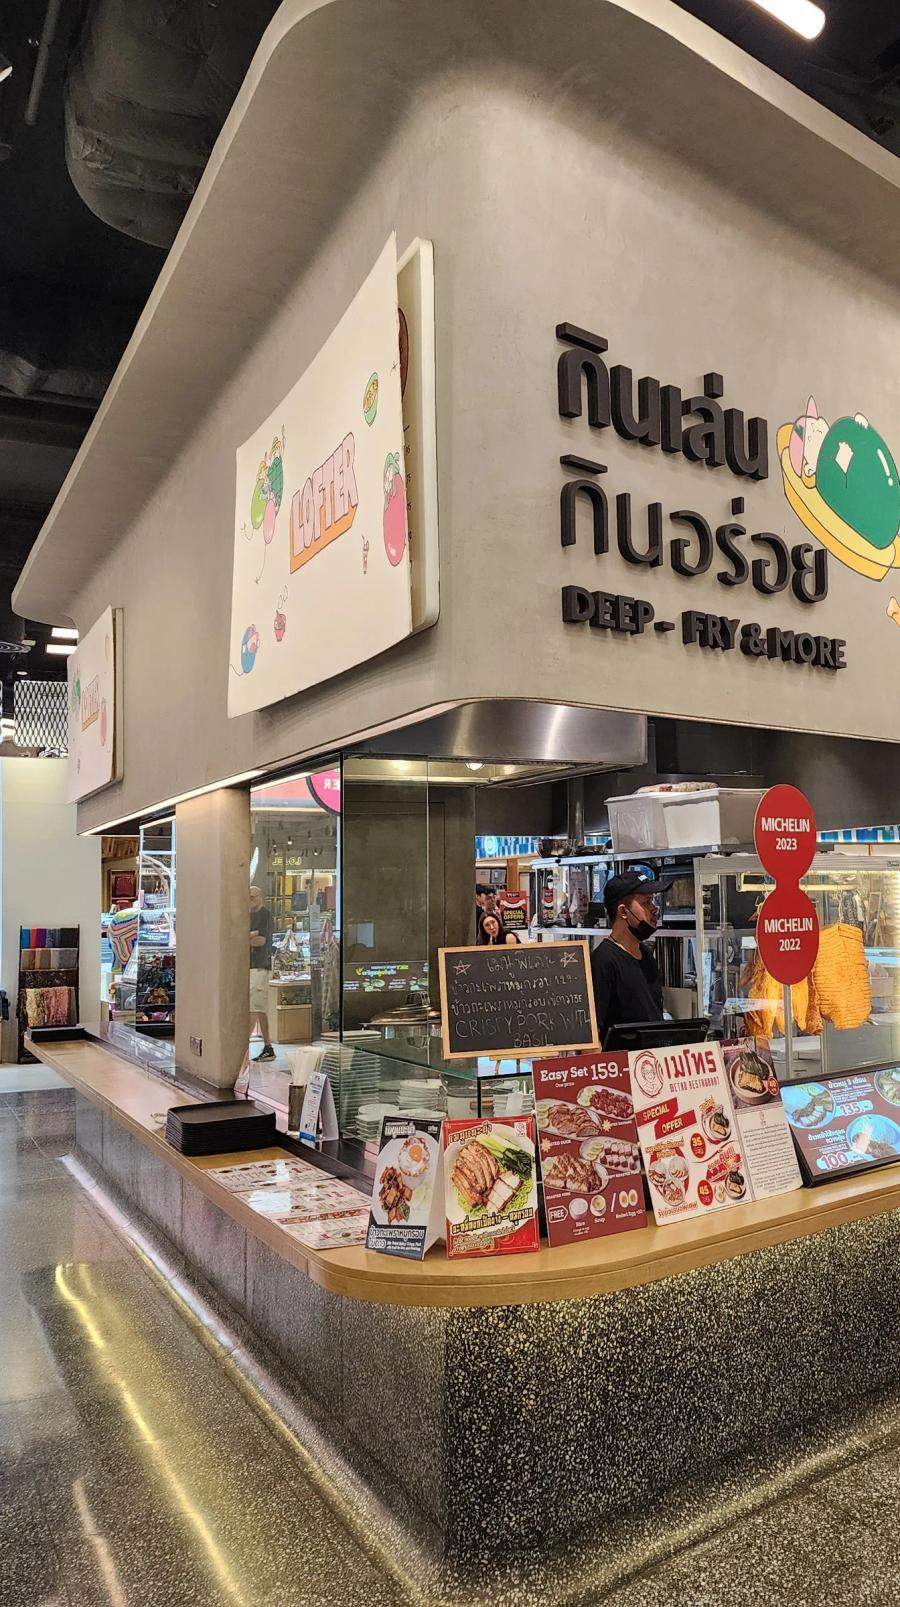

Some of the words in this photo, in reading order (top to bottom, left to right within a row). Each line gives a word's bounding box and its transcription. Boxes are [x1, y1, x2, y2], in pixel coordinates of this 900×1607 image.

[556, 322, 769, 480] กินเล่น
[291, 431, 359, 558] LOFTER
[560, 454, 829, 604] กินอร่อย
[562, 584, 655, 634] DEEP
[682, 610, 741, 651] FRY
[766, 626, 848, 671] MORE
[761, 816, 810, 833] MICHELIN
[775, 838, 798, 850] 2023
[764, 917, 813, 934] MICHELIN
[779, 938, 801, 951] 2022
[513, 1032, 554, 1048] BASIL
[664, 1048, 717, 1079] เมโทร
[540, 1068, 568, 1082] Easy
[570, 1066, 588, 1078] Set
[642, 1104, 670, 1121] SPECIAL
[661, 1118, 684, 1134] OFFER
[691, 1136, 702, 1146] 35
[699, 1185, 710, 1196] 45
[550, 1209, 566, 1220] FREE
